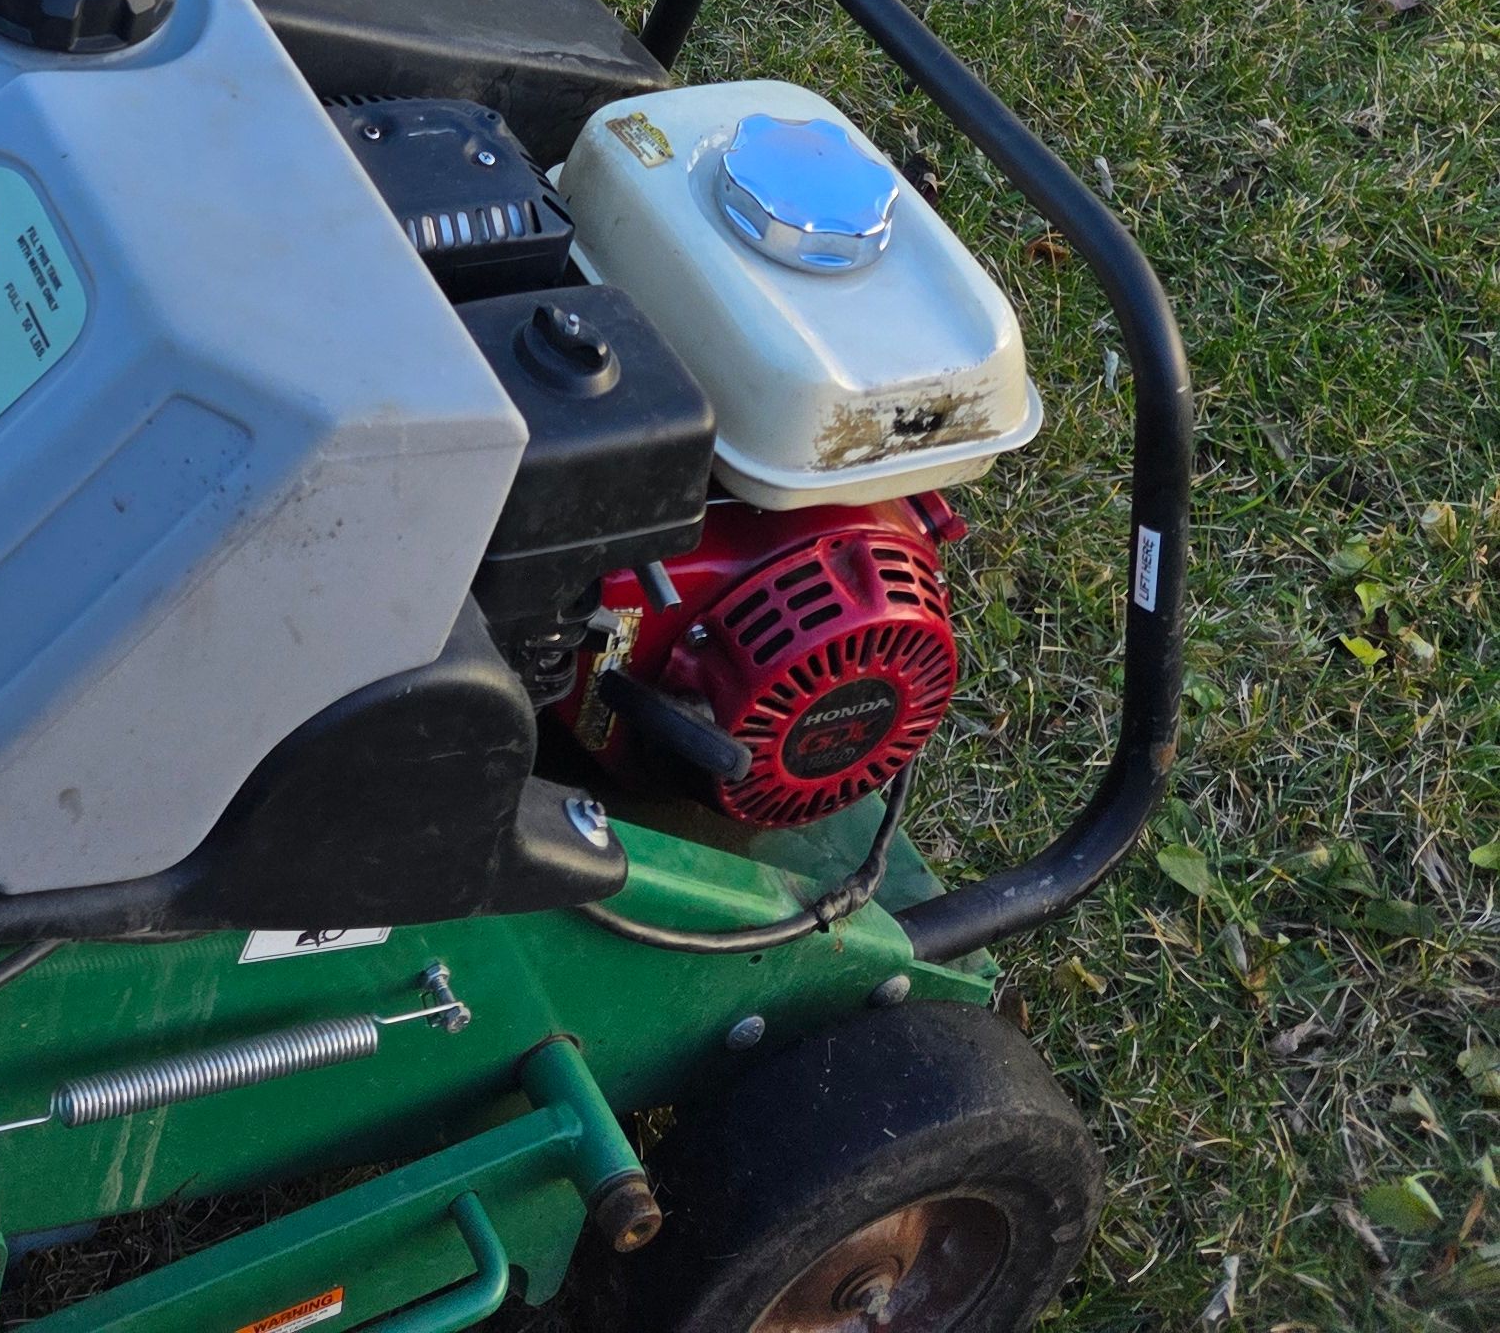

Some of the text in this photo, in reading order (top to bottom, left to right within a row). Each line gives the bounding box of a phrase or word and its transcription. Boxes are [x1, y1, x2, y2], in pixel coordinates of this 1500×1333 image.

[1139, 536, 1155, 602] LIFT HERE
[803, 697, 891, 727] HONDA
[253, 1294, 333, 1333] WARNING
